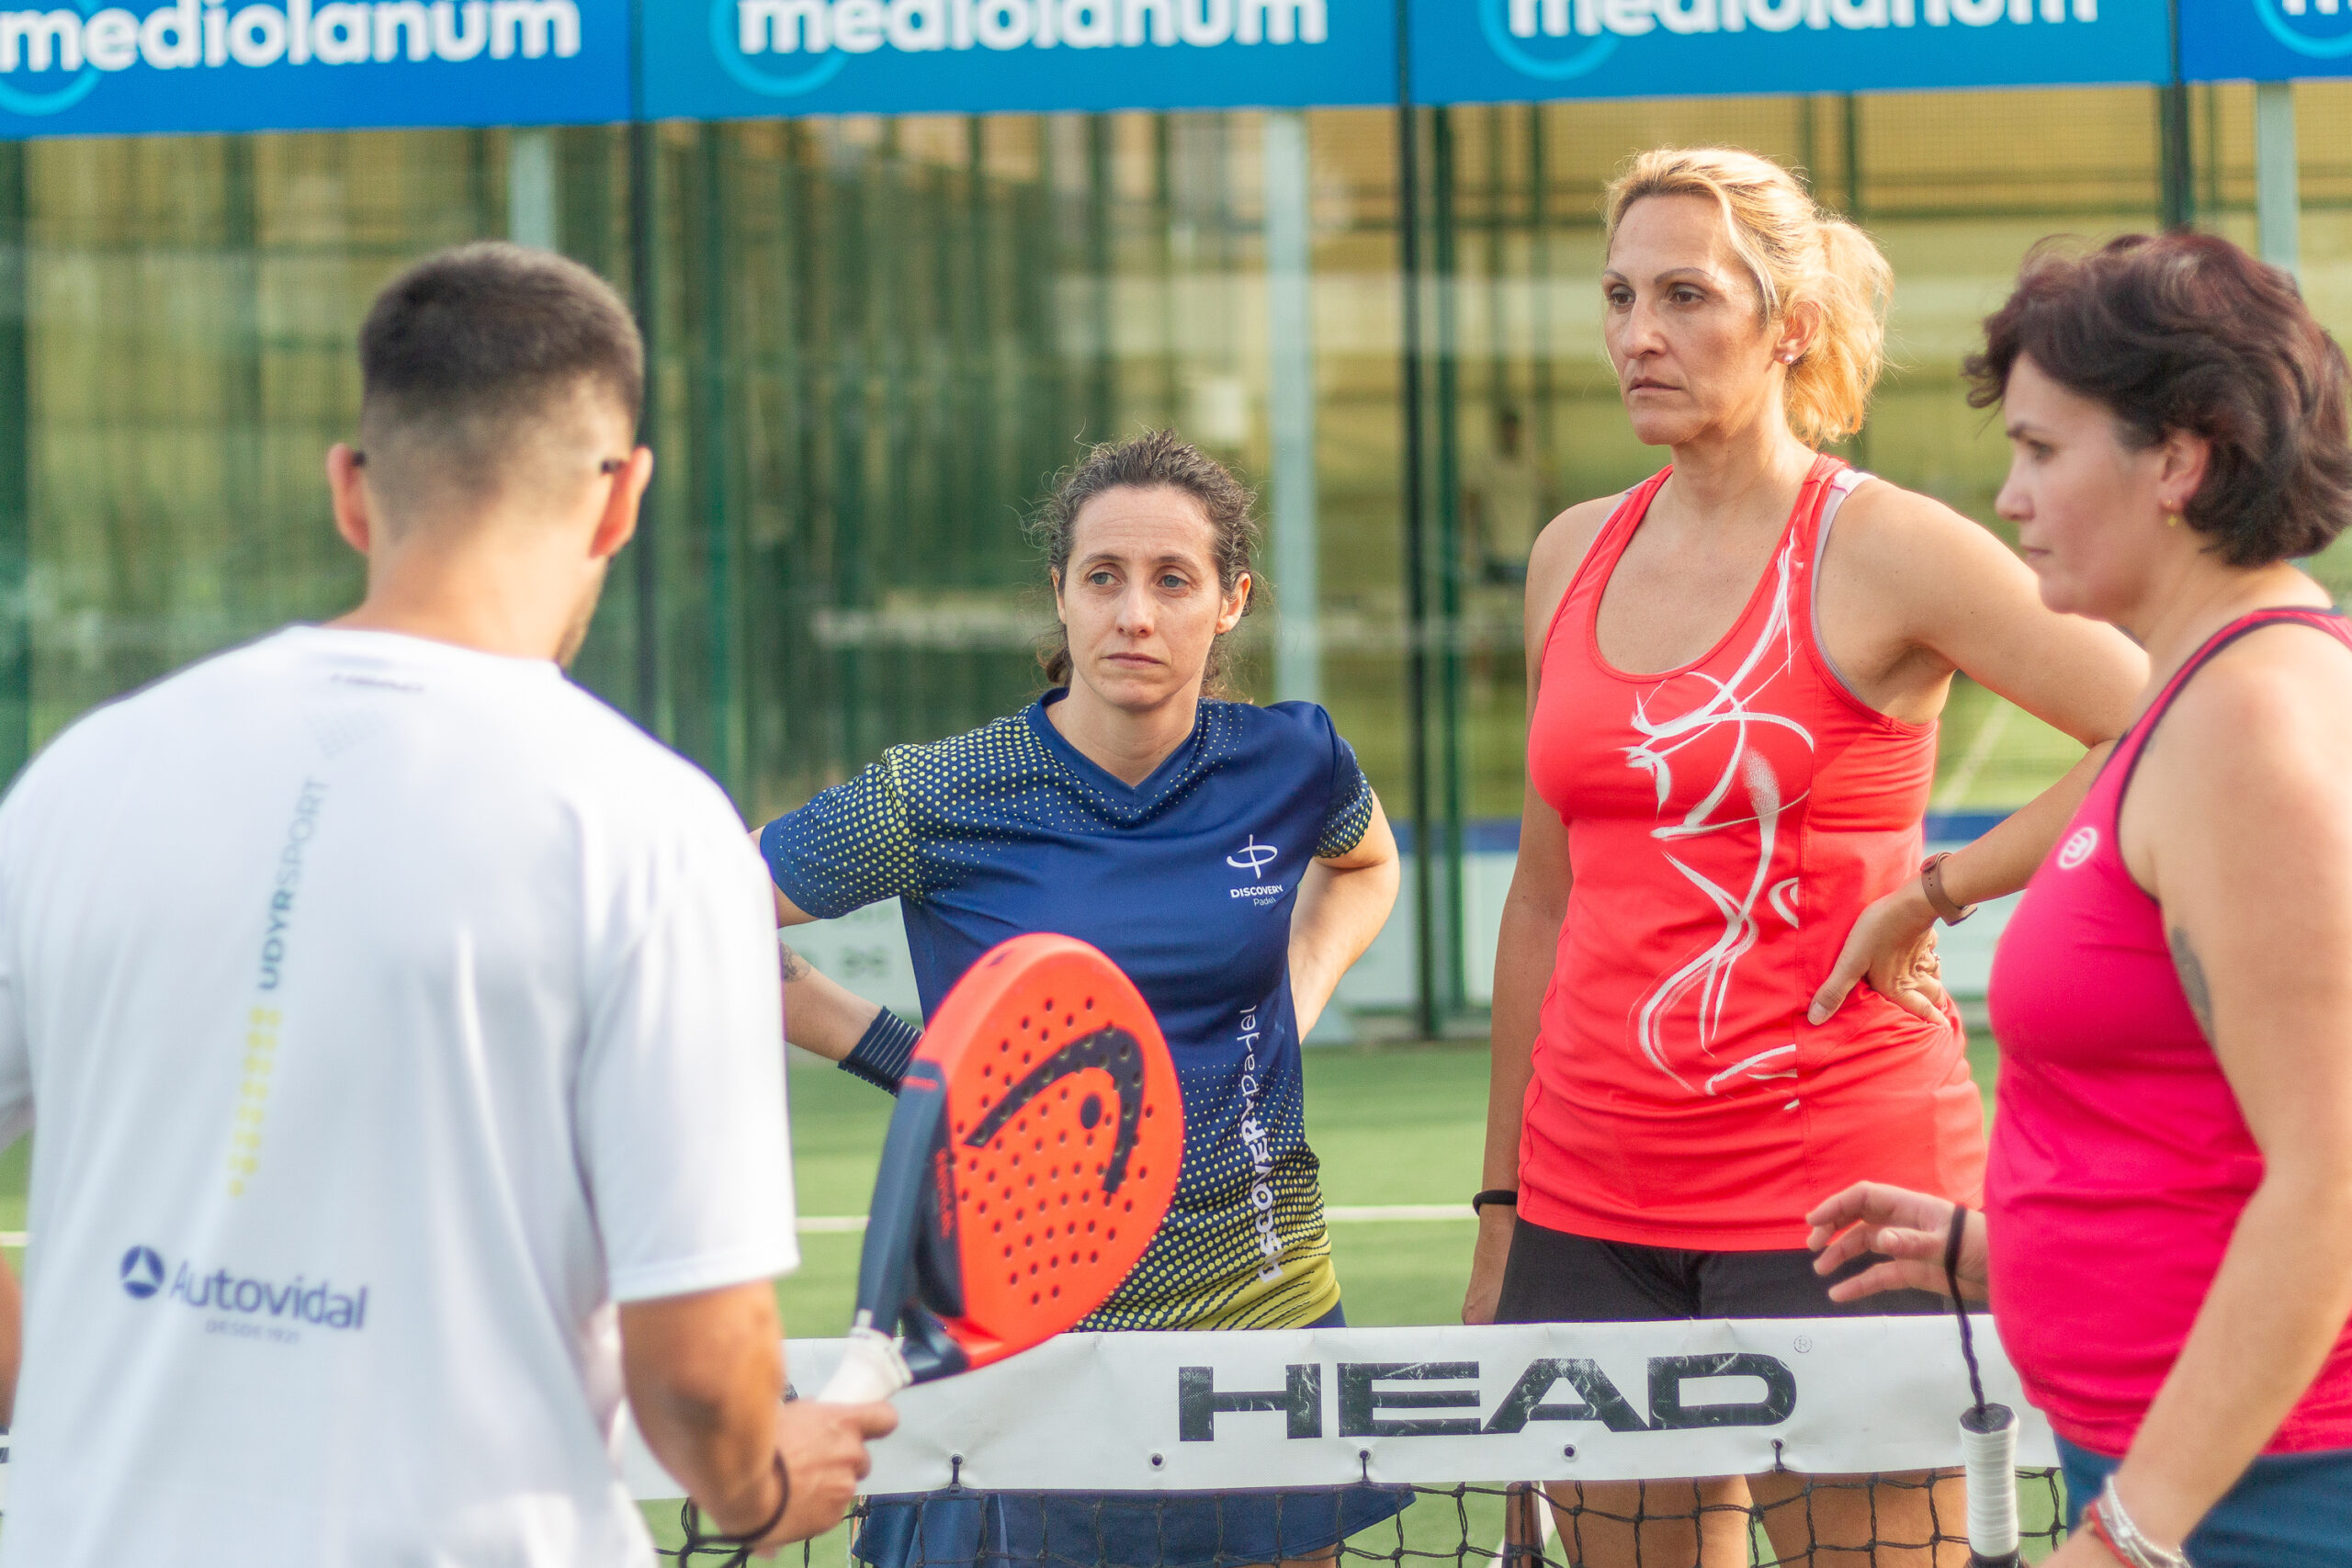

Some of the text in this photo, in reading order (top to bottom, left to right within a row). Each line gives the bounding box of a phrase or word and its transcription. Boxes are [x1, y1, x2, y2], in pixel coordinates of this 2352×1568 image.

[0, 0, 582, 73] mediolanum
[1229, 884, 1284, 898] DISCOVERY
[1252, 897, 1277, 908] Padel
[169, 1259, 369, 1330] Autovidal
[1178, 1352, 1798, 1442] HEAD
